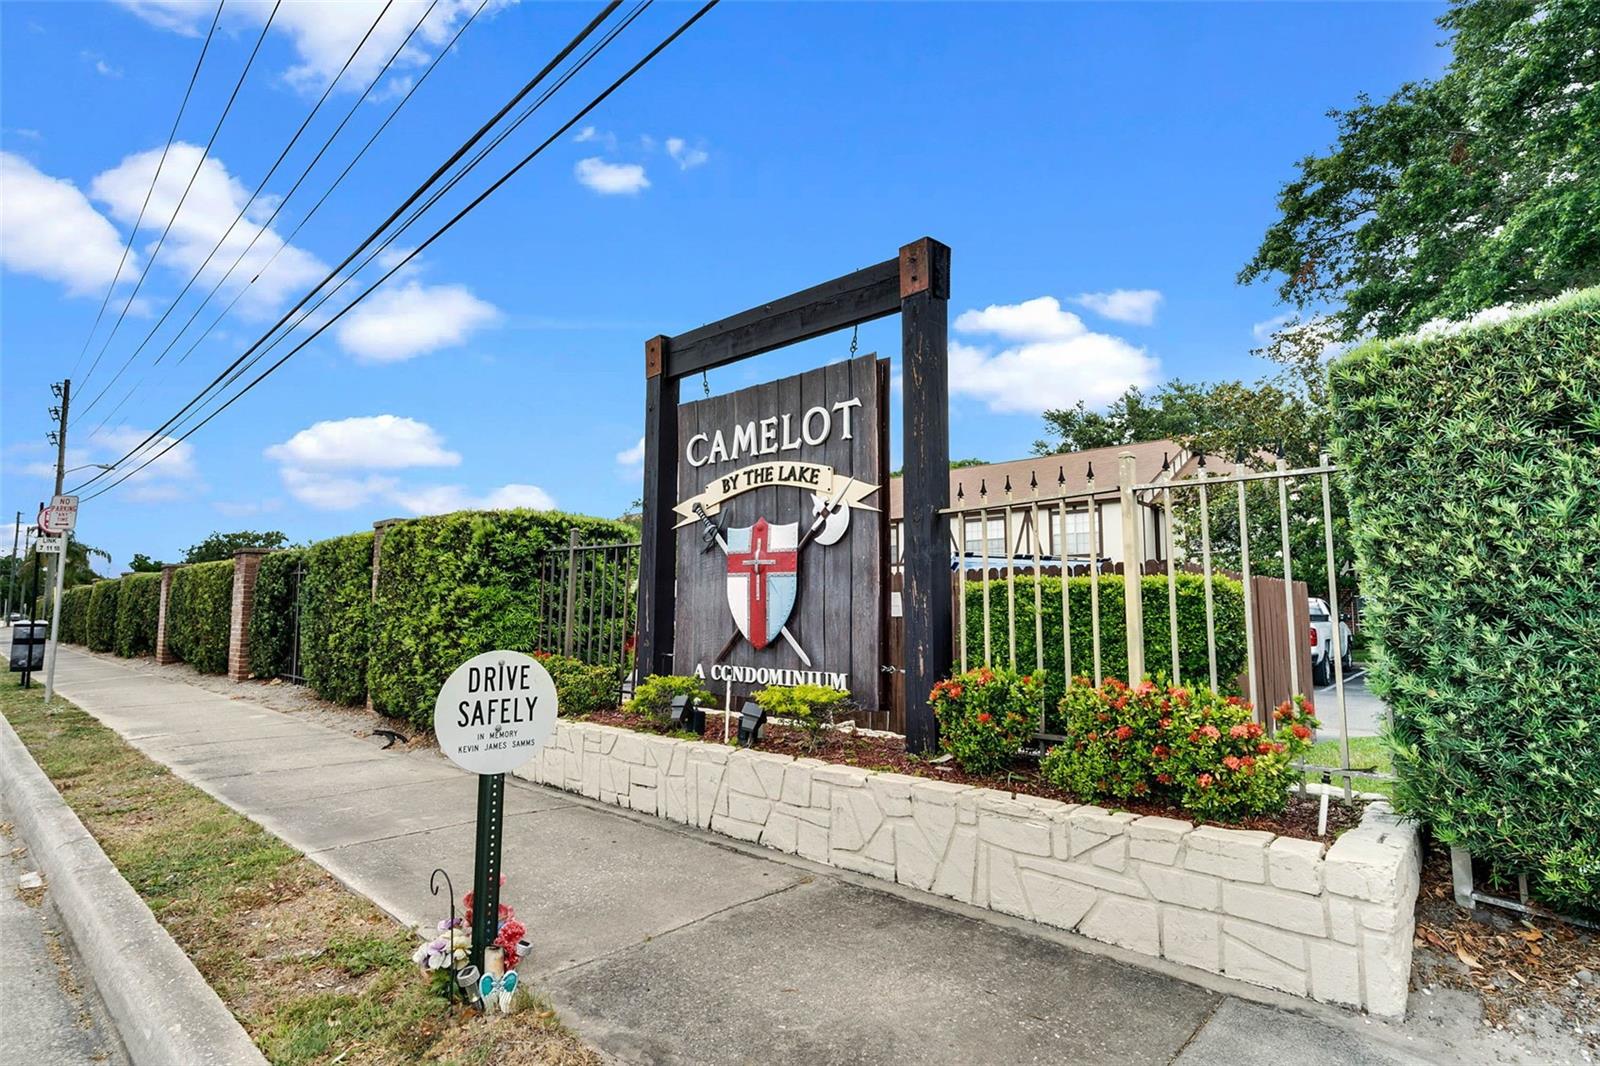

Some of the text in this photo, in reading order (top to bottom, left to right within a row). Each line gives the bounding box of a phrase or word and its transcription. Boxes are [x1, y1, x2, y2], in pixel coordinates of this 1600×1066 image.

[686, 397, 863, 467] CAMELOT
[722, 465, 821, 494] BY THE LAKE
[468, 665, 531, 693] DRIVE
[694, 663, 848, 691] A CONDOMINIUM
[457, 696, 538, 727] SAFELY
[458, 739, 535, 754] KEVIN JAMES SAMMS
[489, 730, 518, 739] MEMORY
